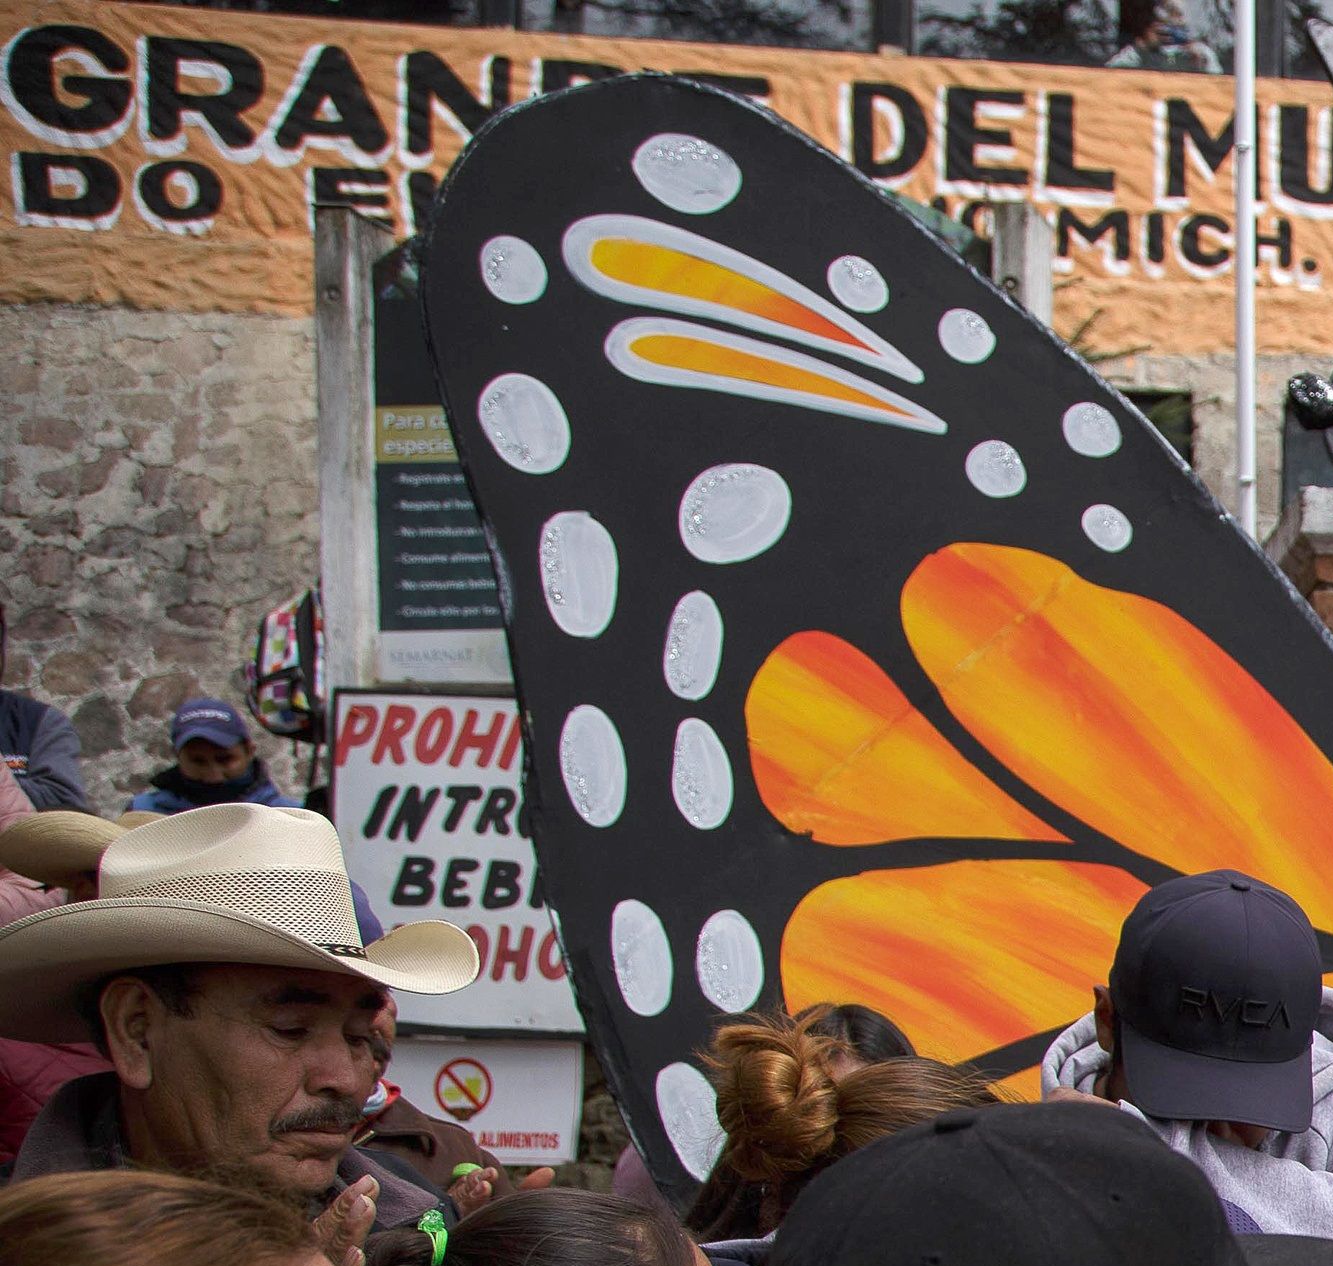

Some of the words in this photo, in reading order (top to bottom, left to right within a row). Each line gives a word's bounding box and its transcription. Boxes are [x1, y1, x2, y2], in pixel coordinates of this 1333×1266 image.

[3, 24, 773, 166] GRAN
[840, 80, 1116, 208] DEL
[383, 412, 425, 431] Para
[363, 784, 533, 842] INTR
[480, 1131, 560, 1149] ALIMENTOS
